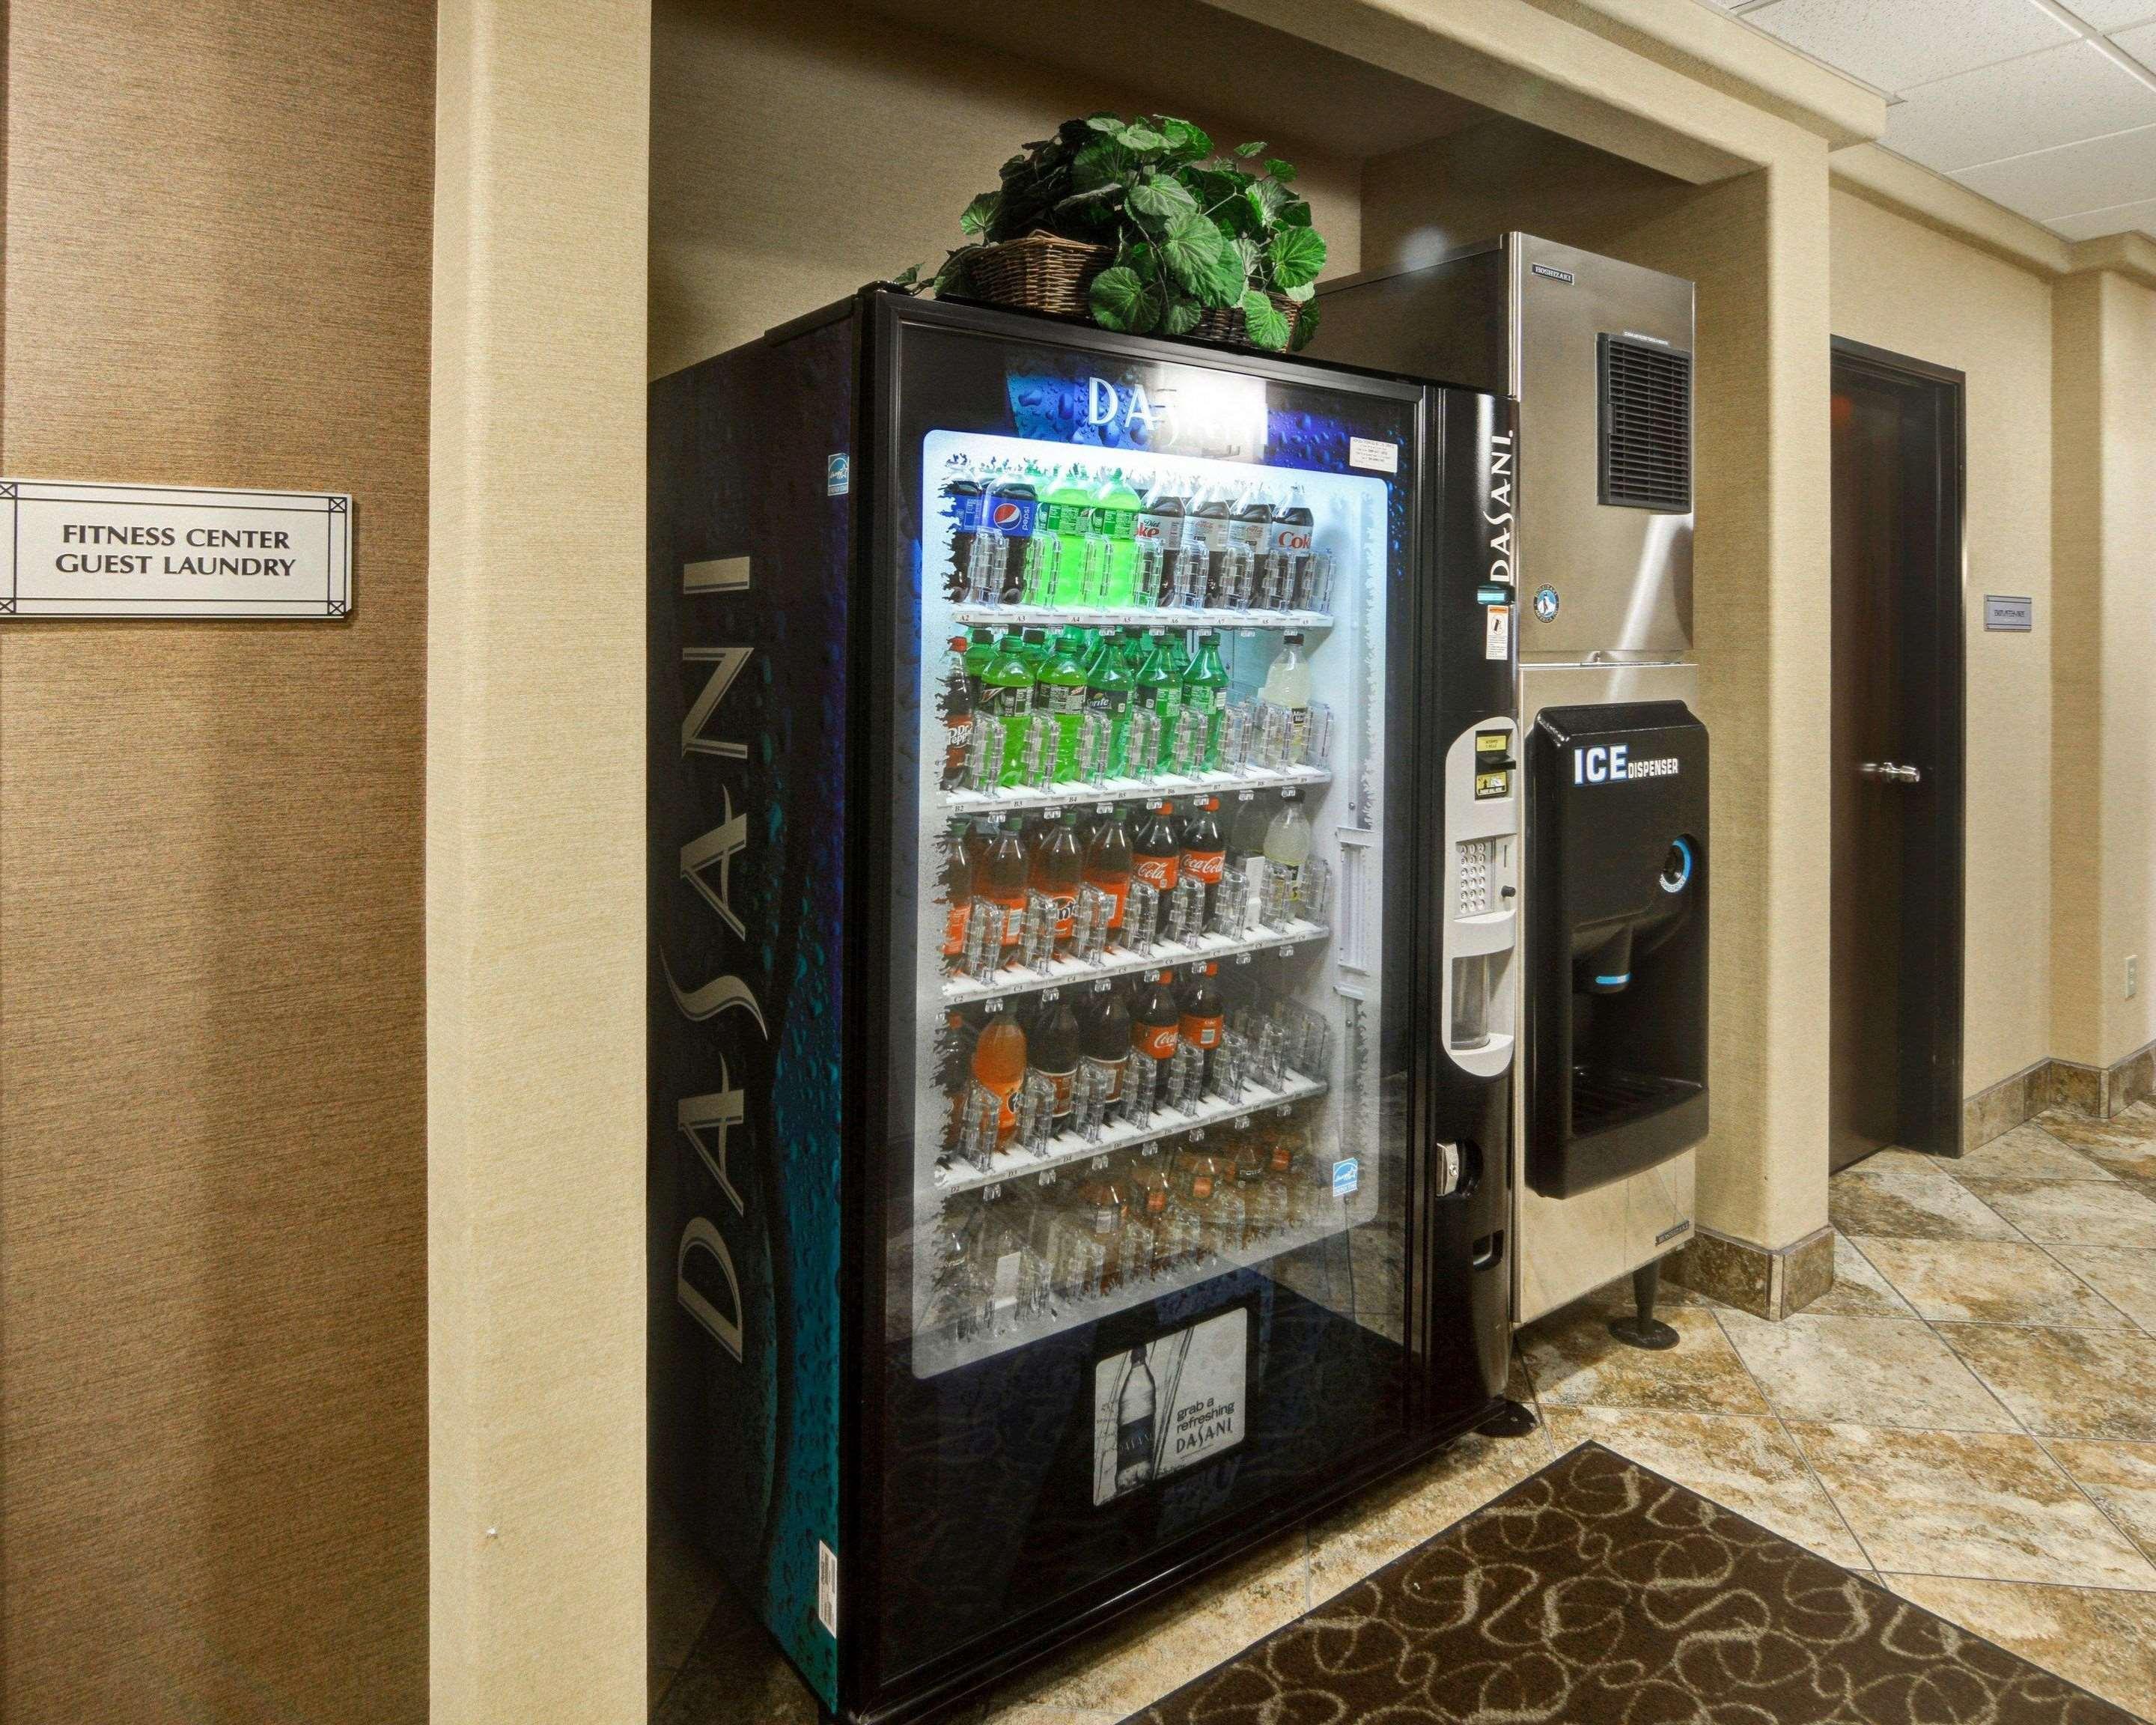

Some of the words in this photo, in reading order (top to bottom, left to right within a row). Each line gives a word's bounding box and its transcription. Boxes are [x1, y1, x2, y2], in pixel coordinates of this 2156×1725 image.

[1022, 505, 1031, 532] pepsi
[62, 524, 175, 547] FITNESS
[186, 528, 290, 550] CENTER
[55, 553, 153, 574] GUEST
[163, 556, 296, 576] LAUNDRY
[1574, 744, 1627, 785] ICE
[1627, 758, 1678, 779] DISPENSER
[660, 556, 767, 1363] DASANI
[1176, 1402, 1235, 1435] refreshing
[1177, 1401, 1205, 1421] grab
[1207, 1397, 1215, 1408] a
[1176, 1417, 1231, 1453] DASANI
